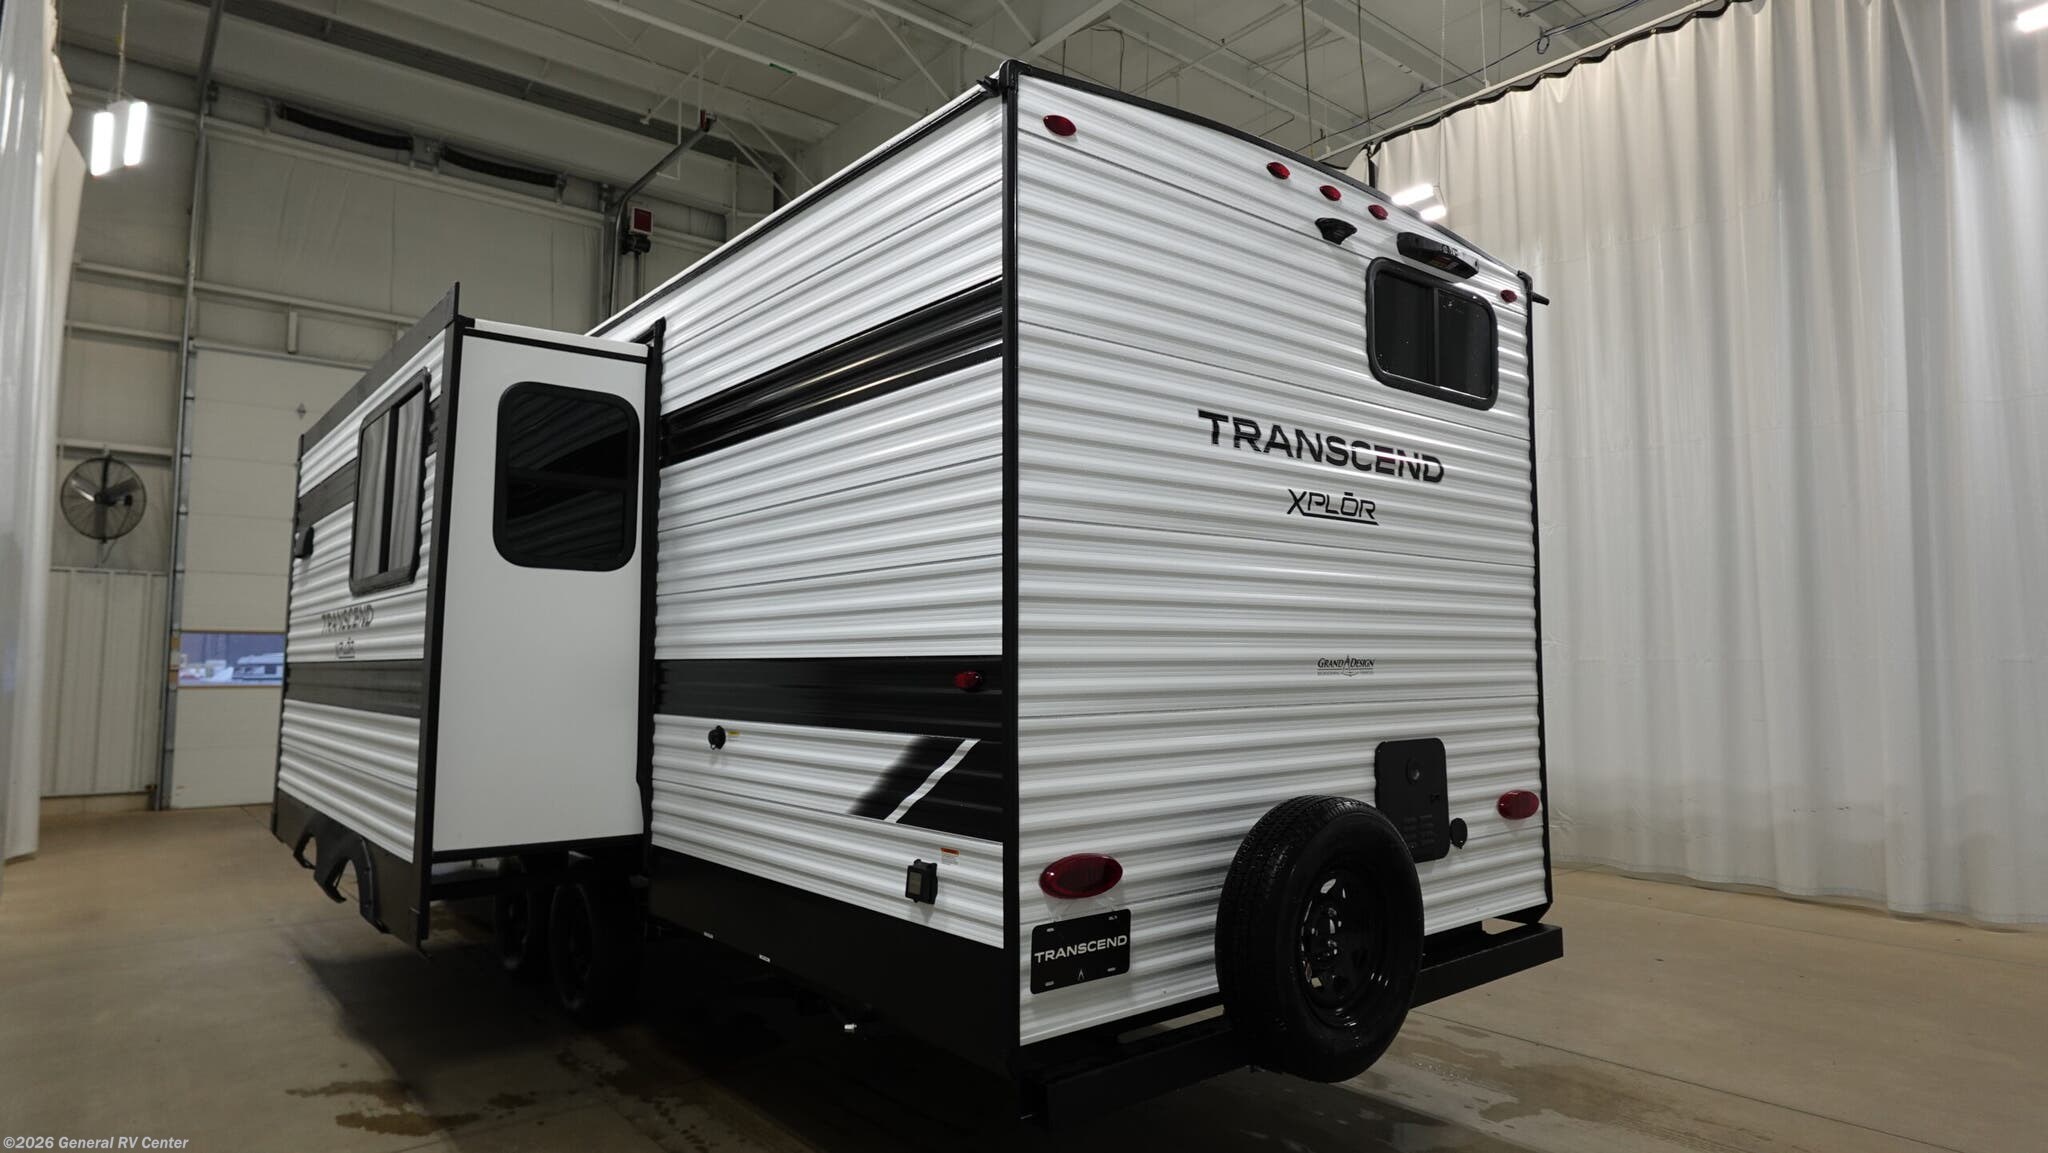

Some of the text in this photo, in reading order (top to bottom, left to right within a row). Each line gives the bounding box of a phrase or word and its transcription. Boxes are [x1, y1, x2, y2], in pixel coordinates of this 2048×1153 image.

[1197, 408, 1445, 484] TRANSCEND
[1317, 657, 1344, 668] GRAND
[1034, 935, 1128, 963] TRANSCEND
